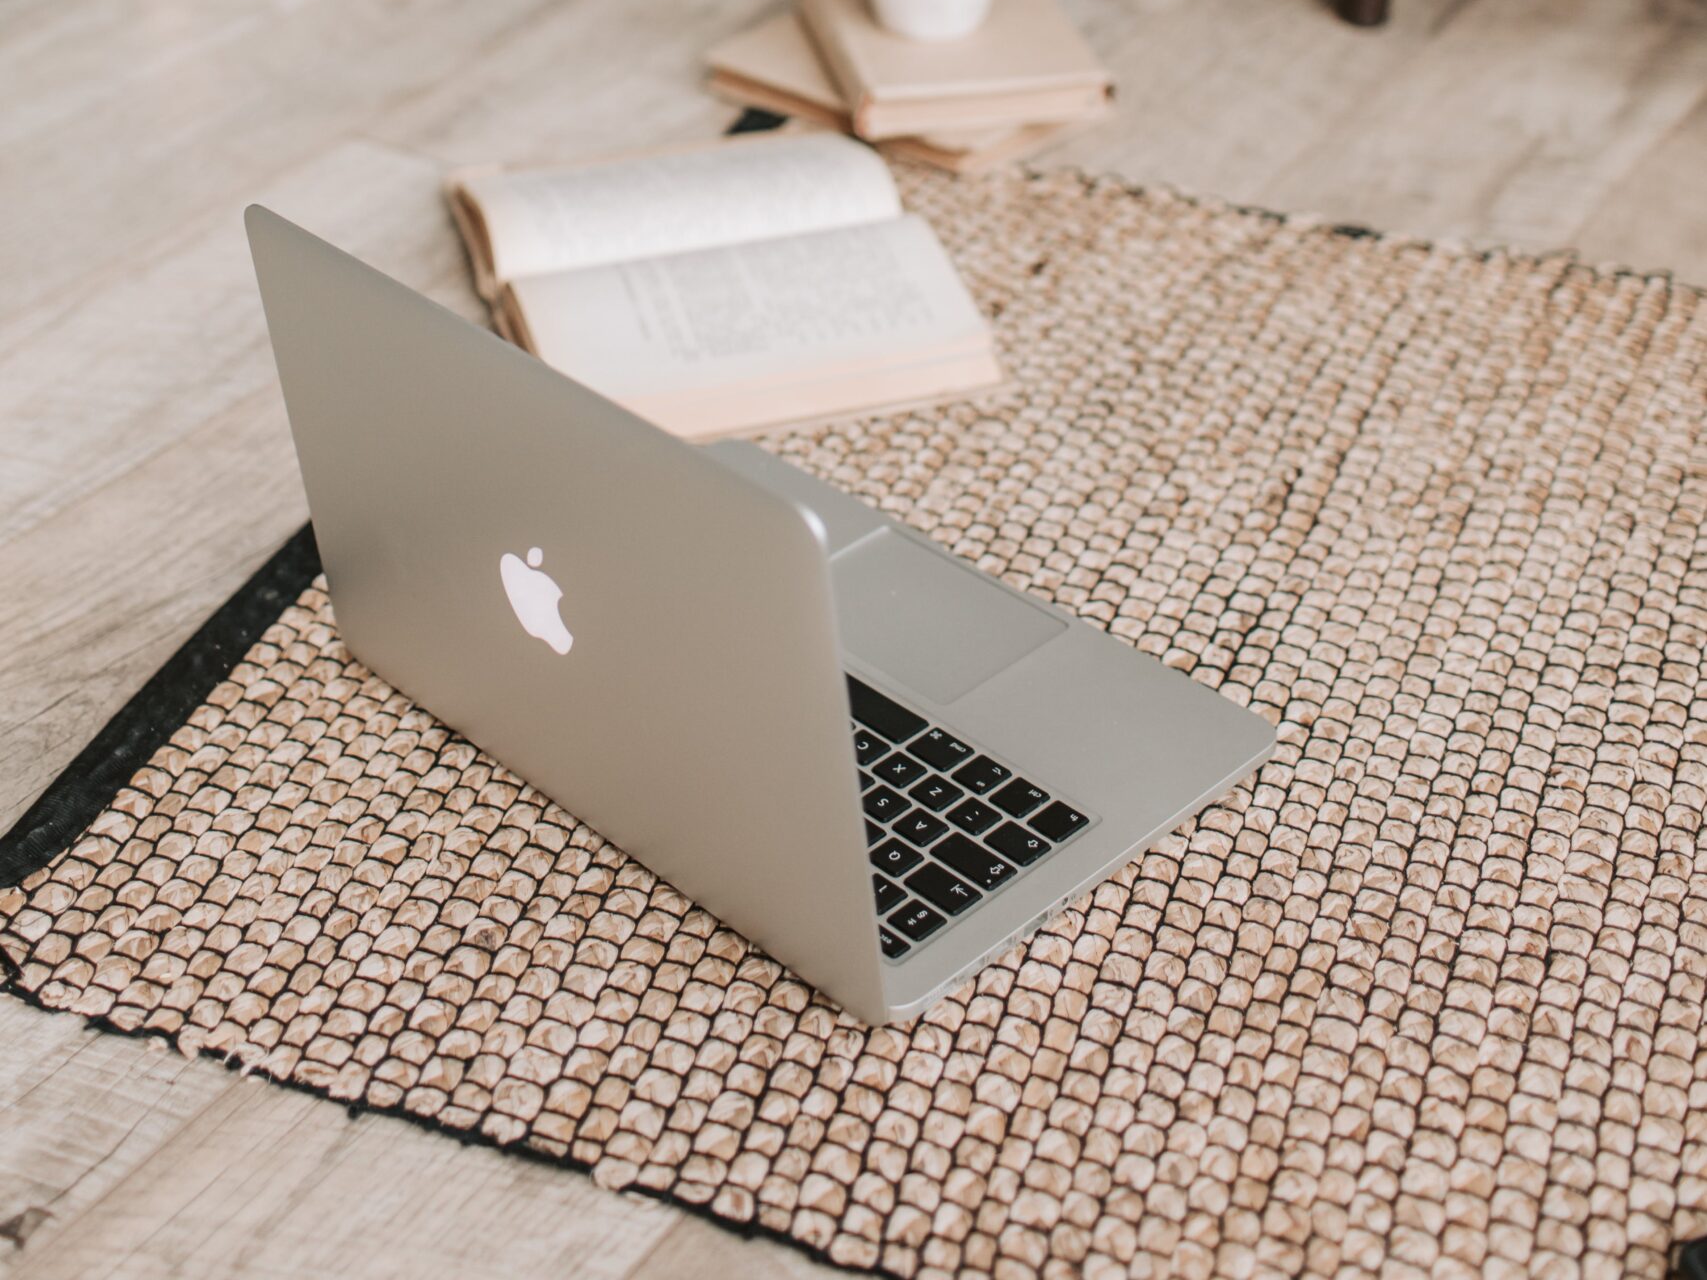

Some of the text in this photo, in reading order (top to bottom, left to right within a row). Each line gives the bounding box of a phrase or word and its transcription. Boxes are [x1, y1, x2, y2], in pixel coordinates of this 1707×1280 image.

[857, 741, 869, 751] C
[949, 742, 967, 752] cmd
[892, 763, 907, 774] X
[929, 786, 942, 797] Z
[1028, 789, 1042, 798] ctrl
[877, 798, 889, 807] S
[1069, 813, 1079, 822] fn
[915, 821, 928, 830] A
[888, 850, 901, 860] Q
